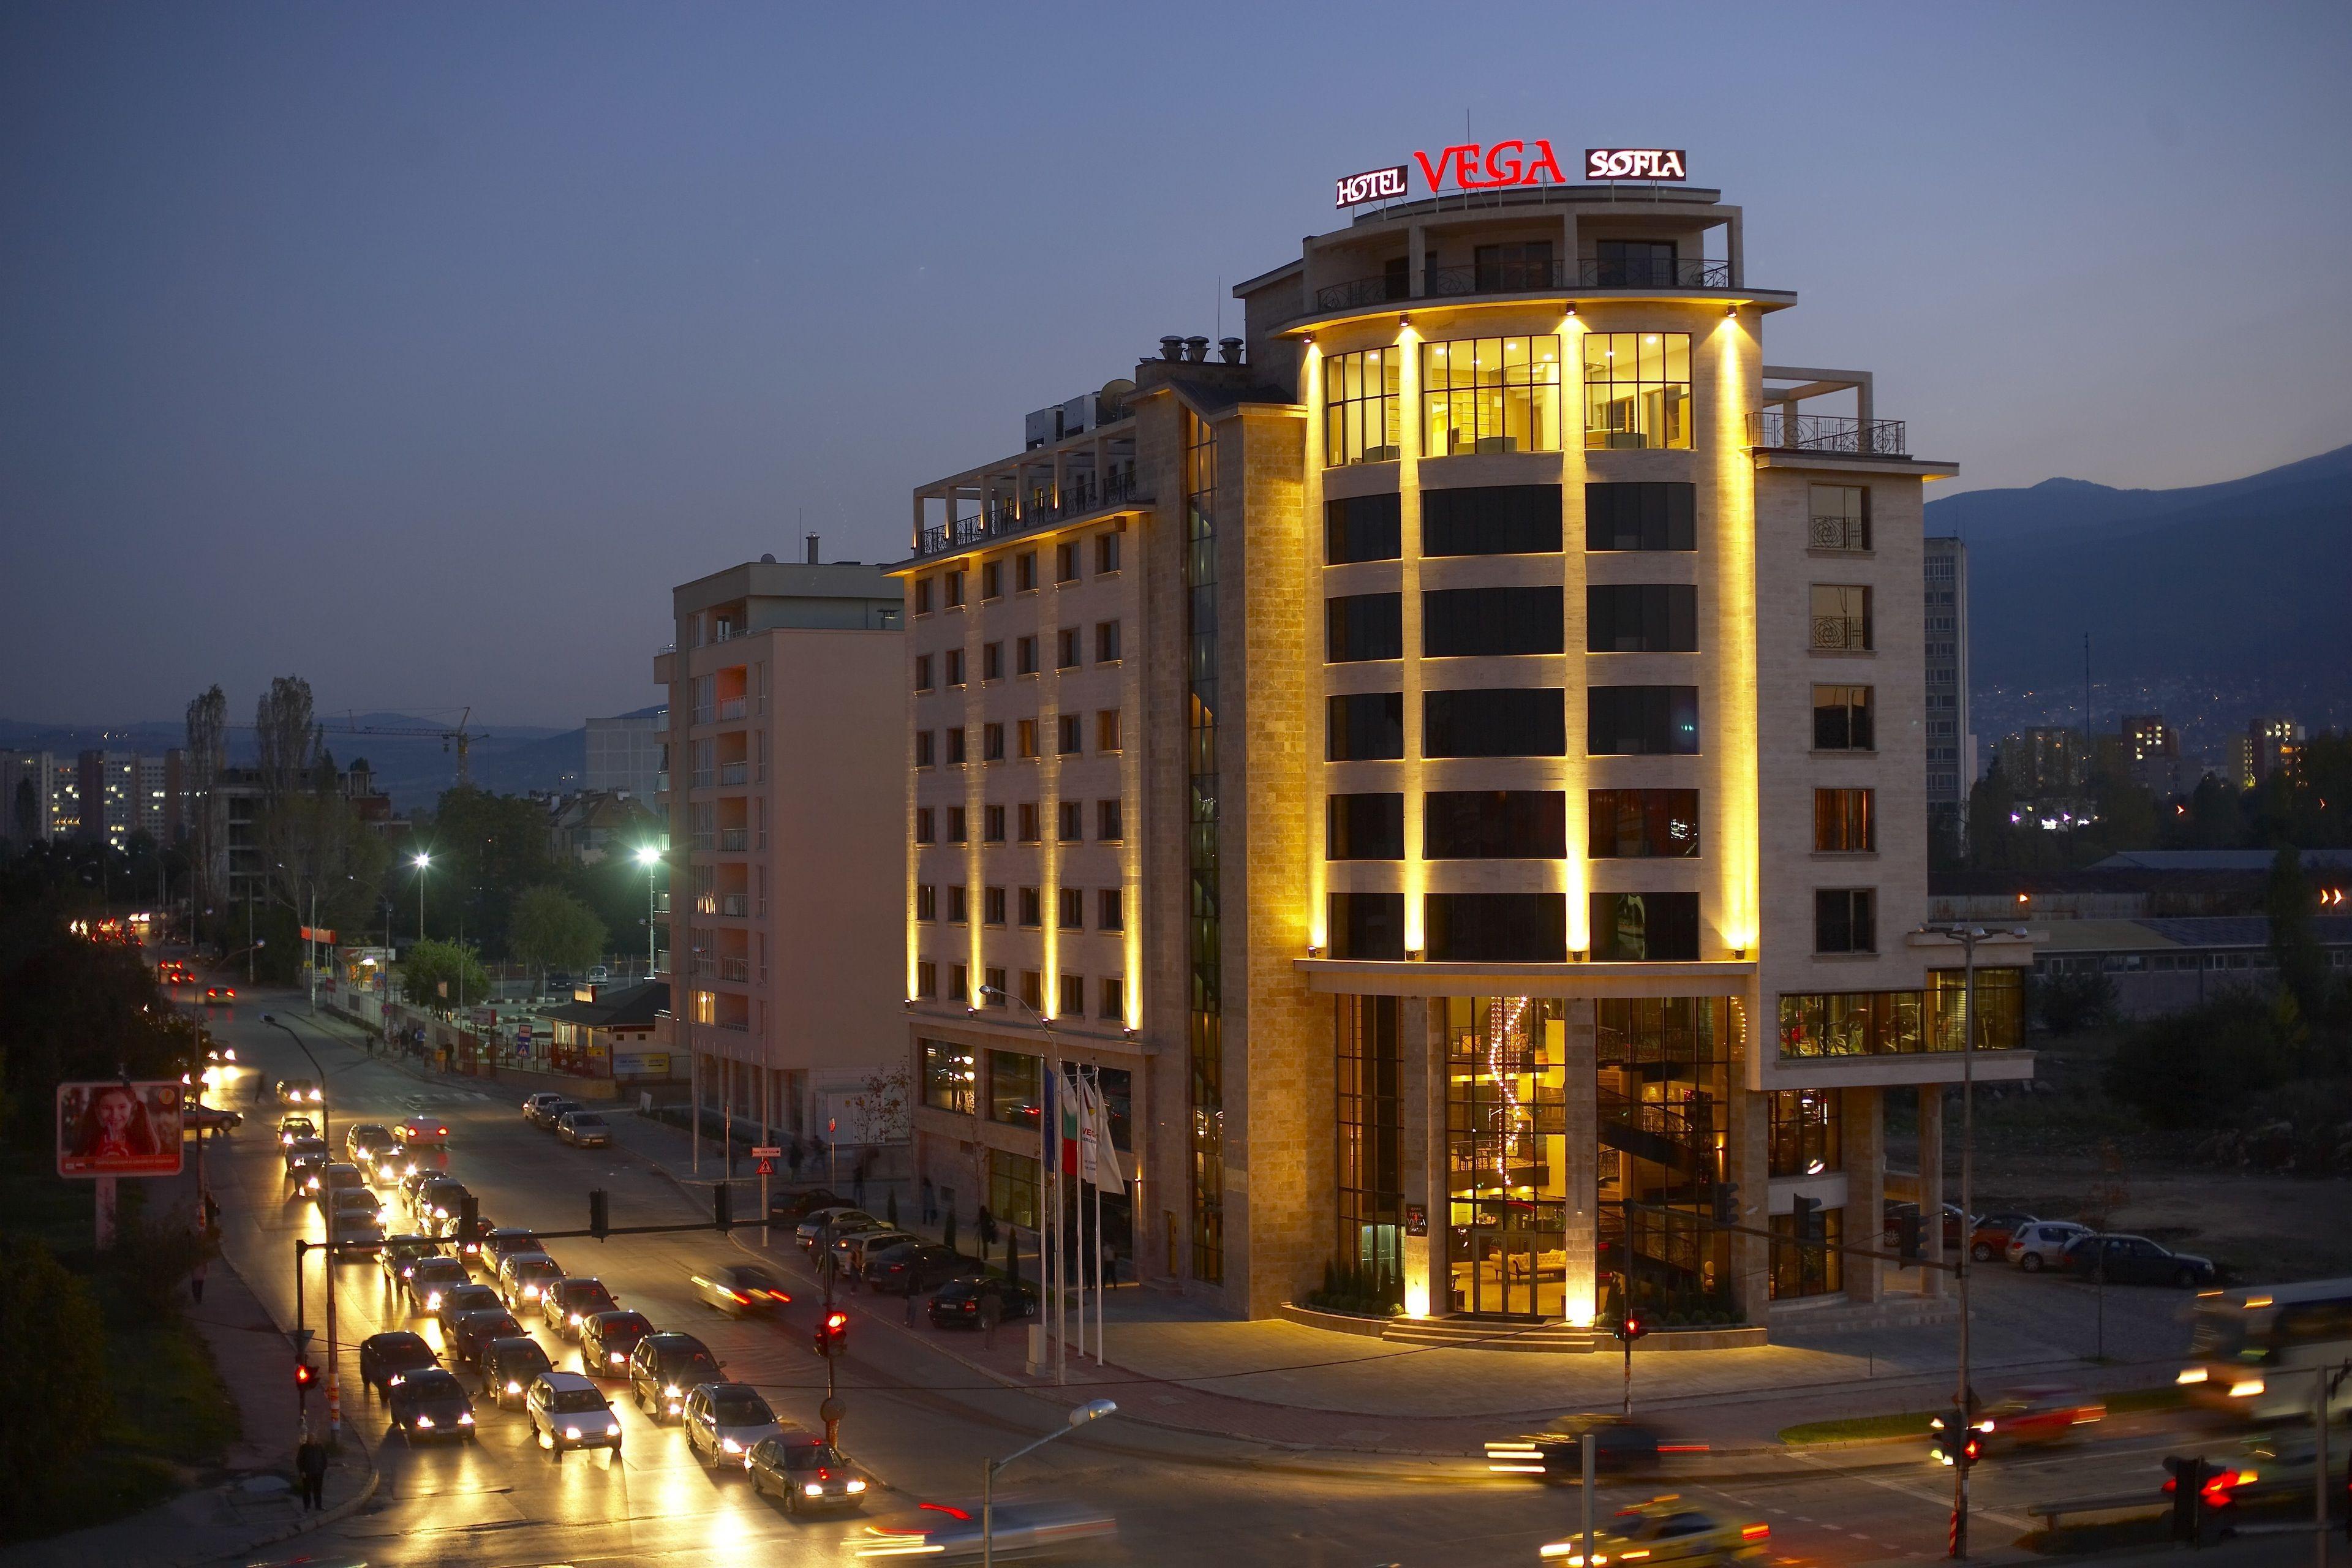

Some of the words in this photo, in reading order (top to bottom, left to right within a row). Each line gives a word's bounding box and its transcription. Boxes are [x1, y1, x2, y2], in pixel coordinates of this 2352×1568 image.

[1336, 168, 1405, 205] HOTEL
[1414, 140, 1566, 192] VEGA
[1588, 151, 1684, 177] SOFIA
